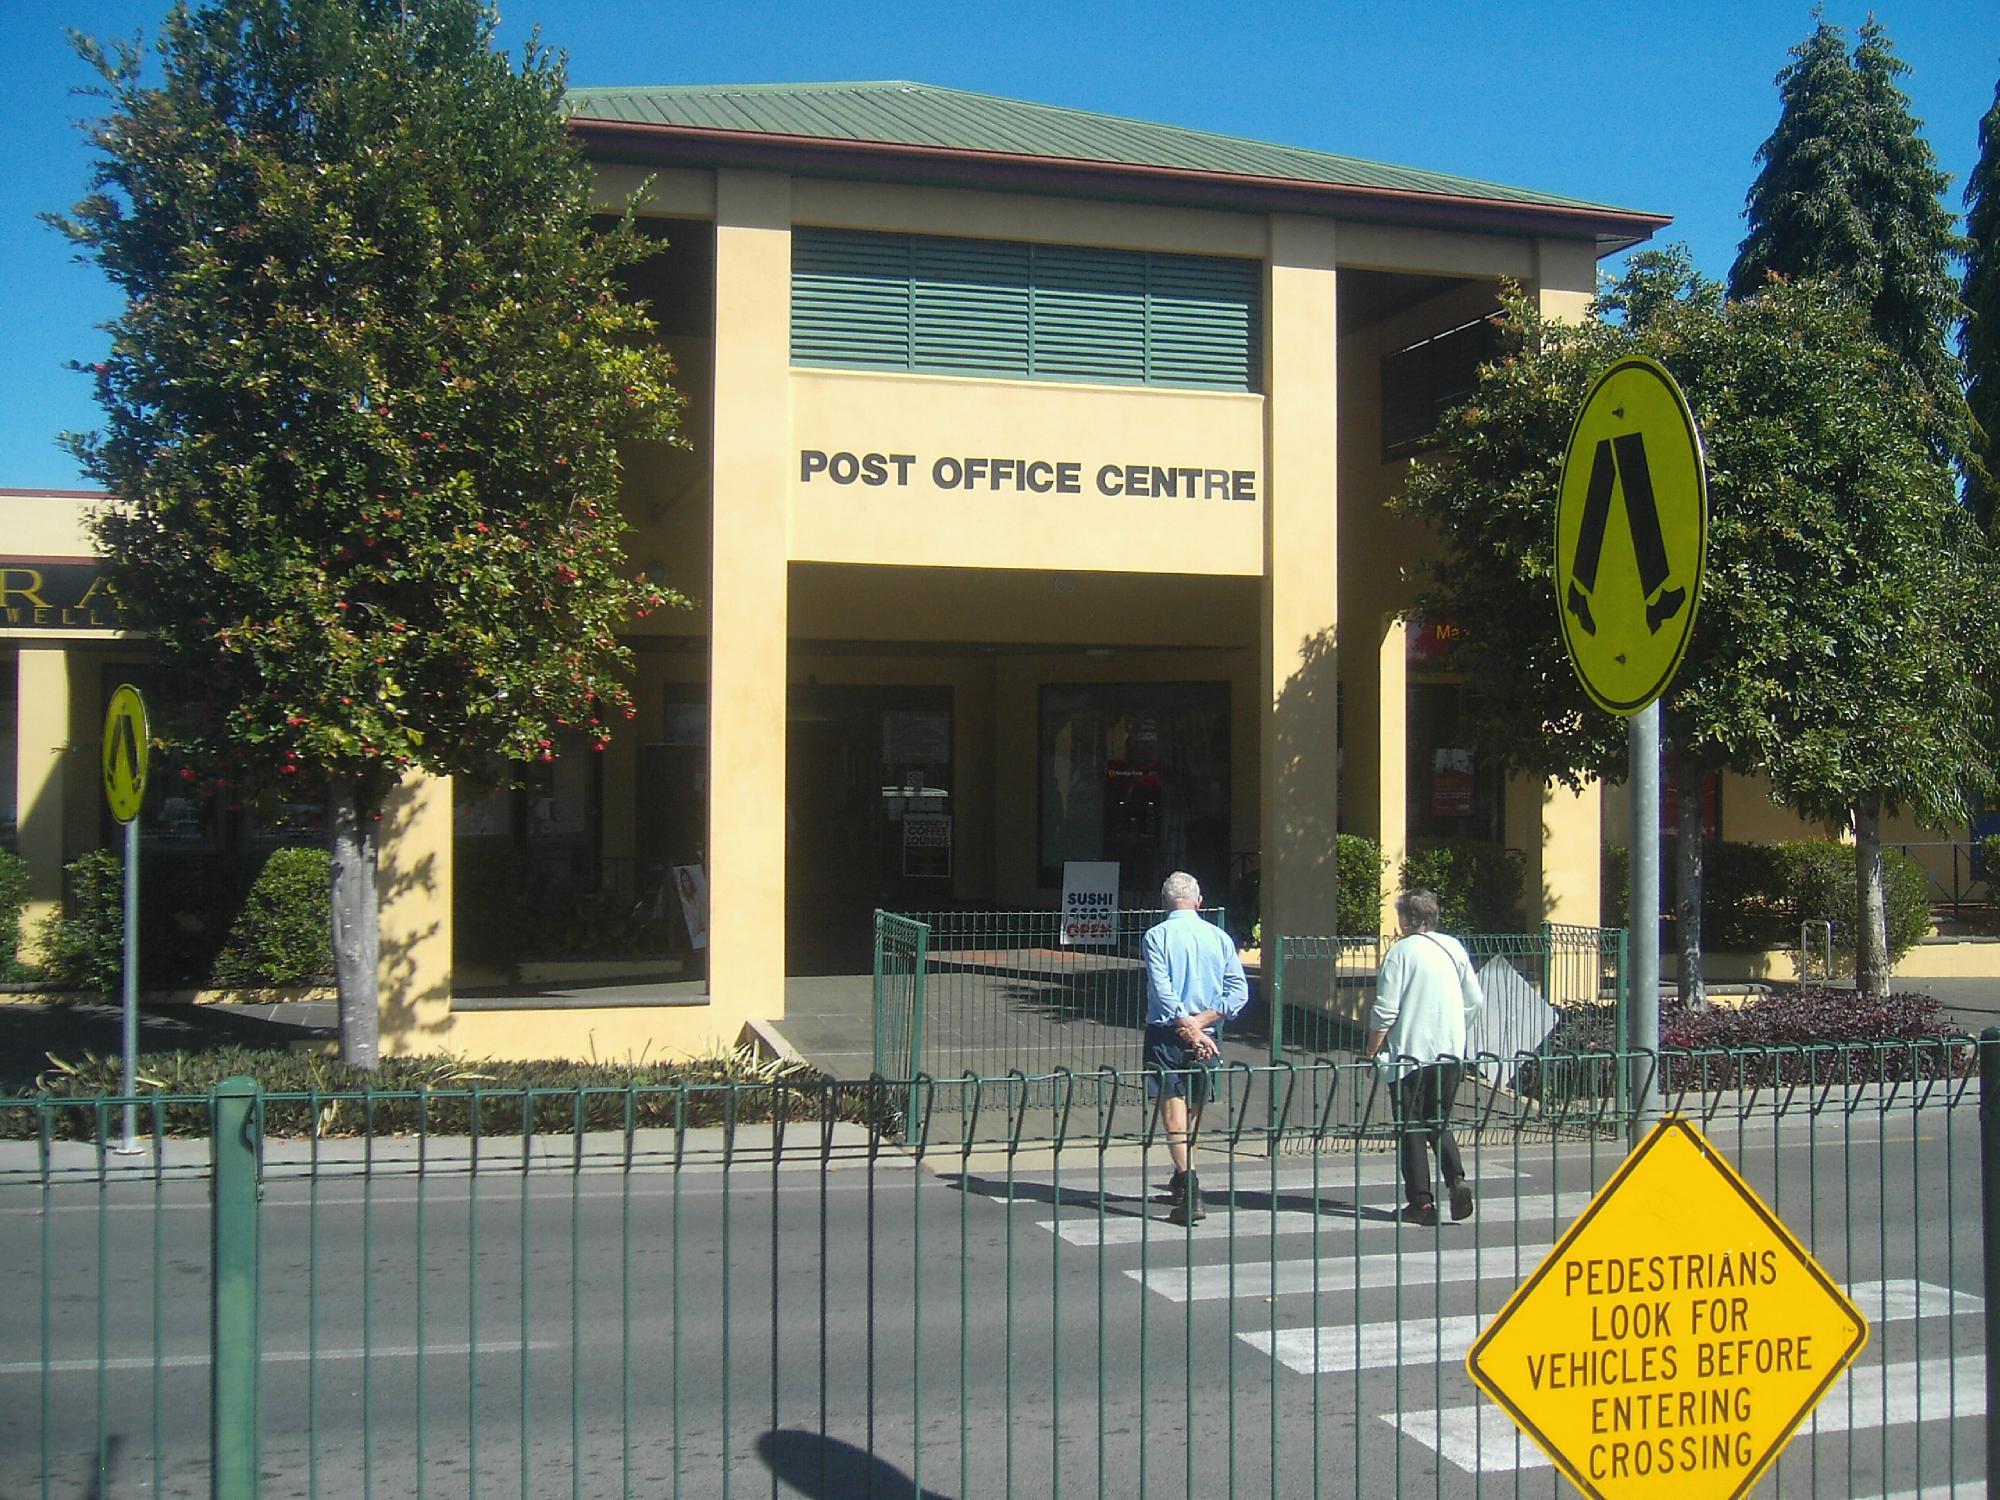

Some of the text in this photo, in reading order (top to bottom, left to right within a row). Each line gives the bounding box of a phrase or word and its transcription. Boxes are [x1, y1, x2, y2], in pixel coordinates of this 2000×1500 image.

[800, 449, 1256, 502] POST OFFICE CENTRE
[1067, 892, 1113, 906] SUSHI
[1066, 923, 1113, 939] OPEN
[1564, 1250, 1777, 1297] PEDESTRIANS
[1591, 1297, 1749, 1342] LOOK FOR
[1526, 1336, 1812, 1391] VEHICLES BEFORE
[1591, 1387, 1752, 1435] ENTERING
[1589, 1432, 1753, 1480] CROSSING
